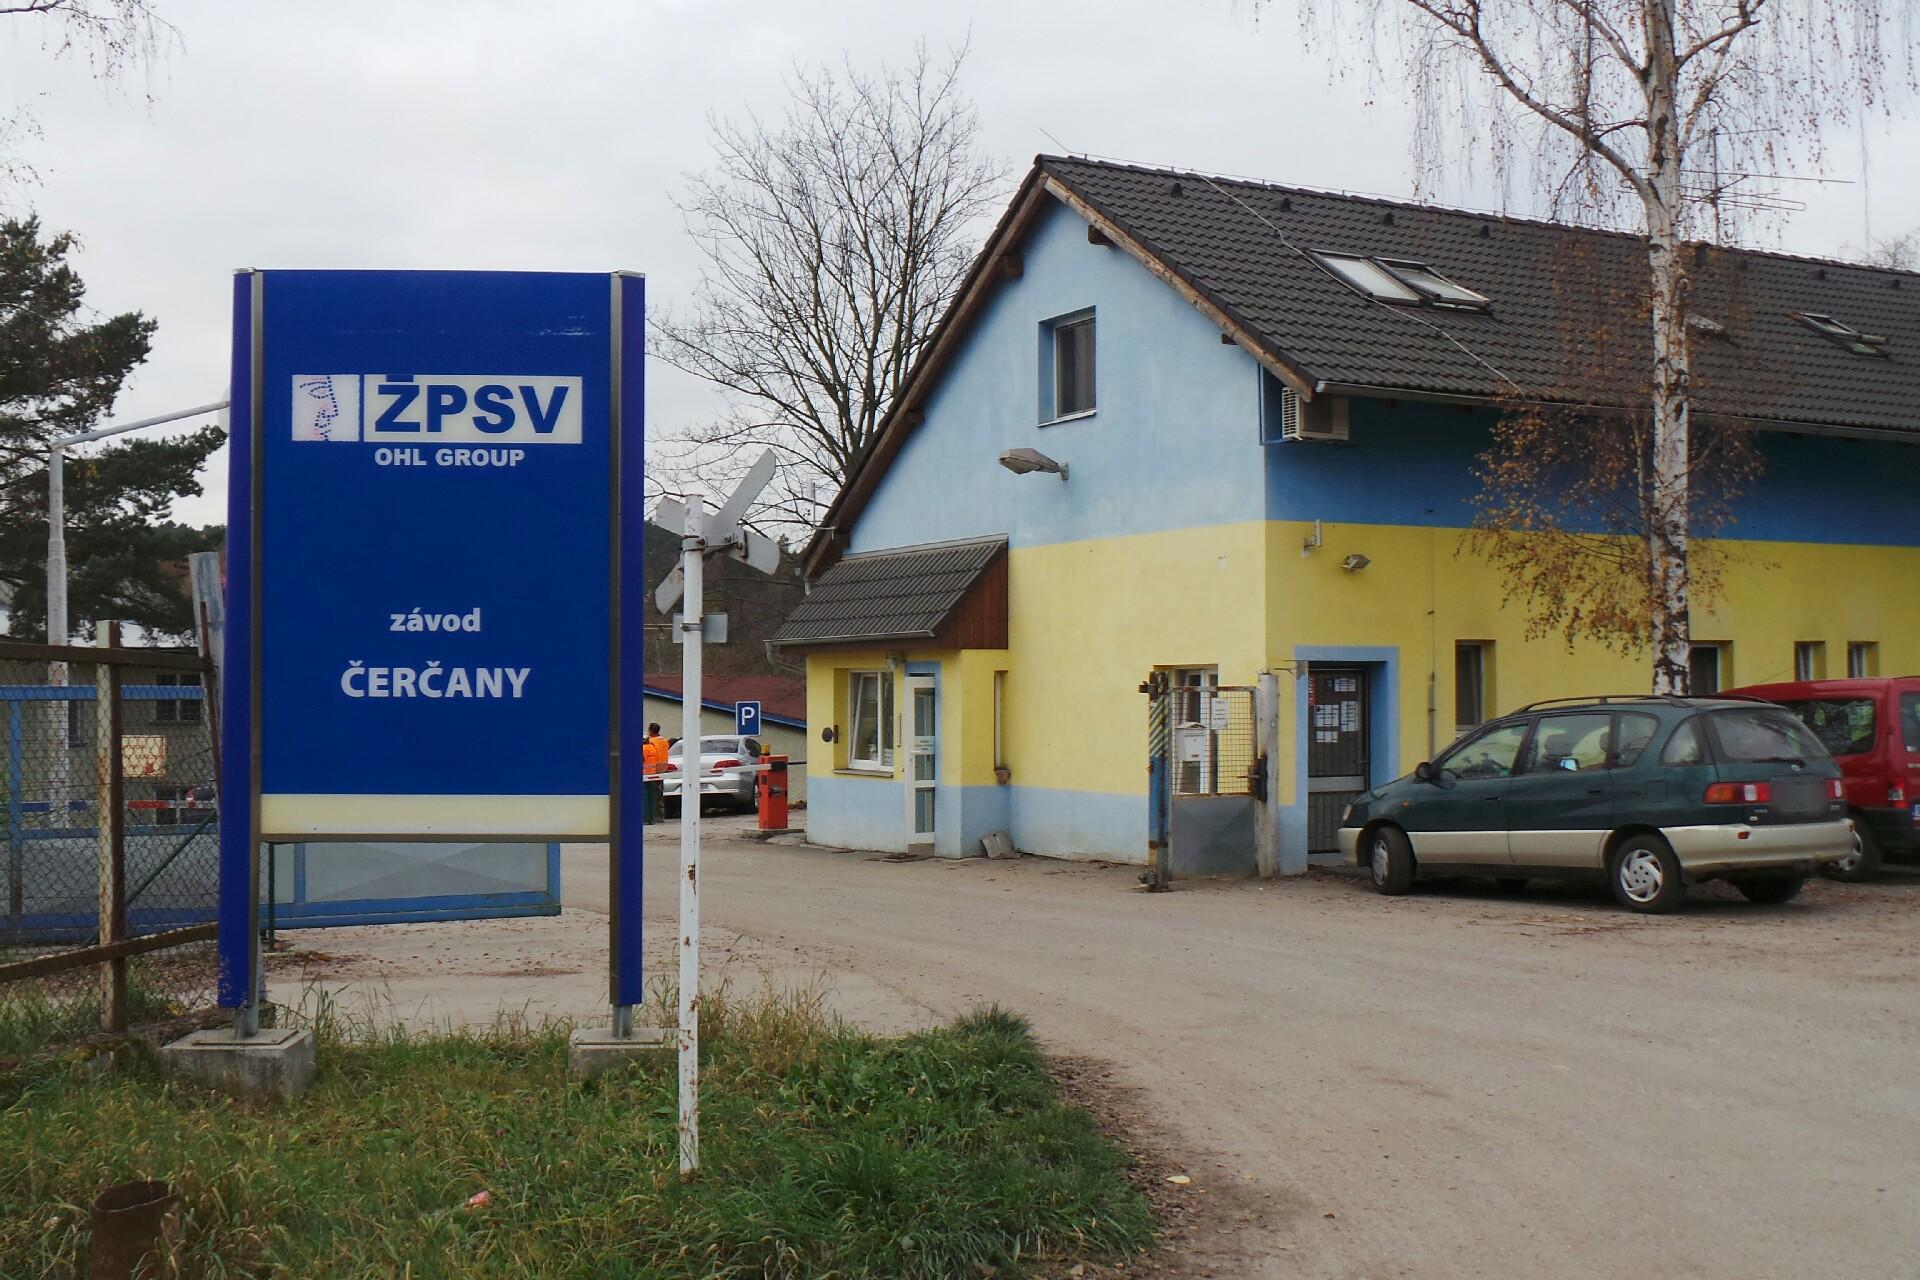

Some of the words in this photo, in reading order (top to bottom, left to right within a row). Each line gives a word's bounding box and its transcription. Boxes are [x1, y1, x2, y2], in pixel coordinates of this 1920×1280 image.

[375, 374, 569, 433] ŽPSV
[374, 448, 427, 466] OHL
[435, 448, 525, 467] GROUP
[389, 607, 481, 633] závod
[340, 660, 531, 698] ČERČANY
[741, 706, 755, 726] P
